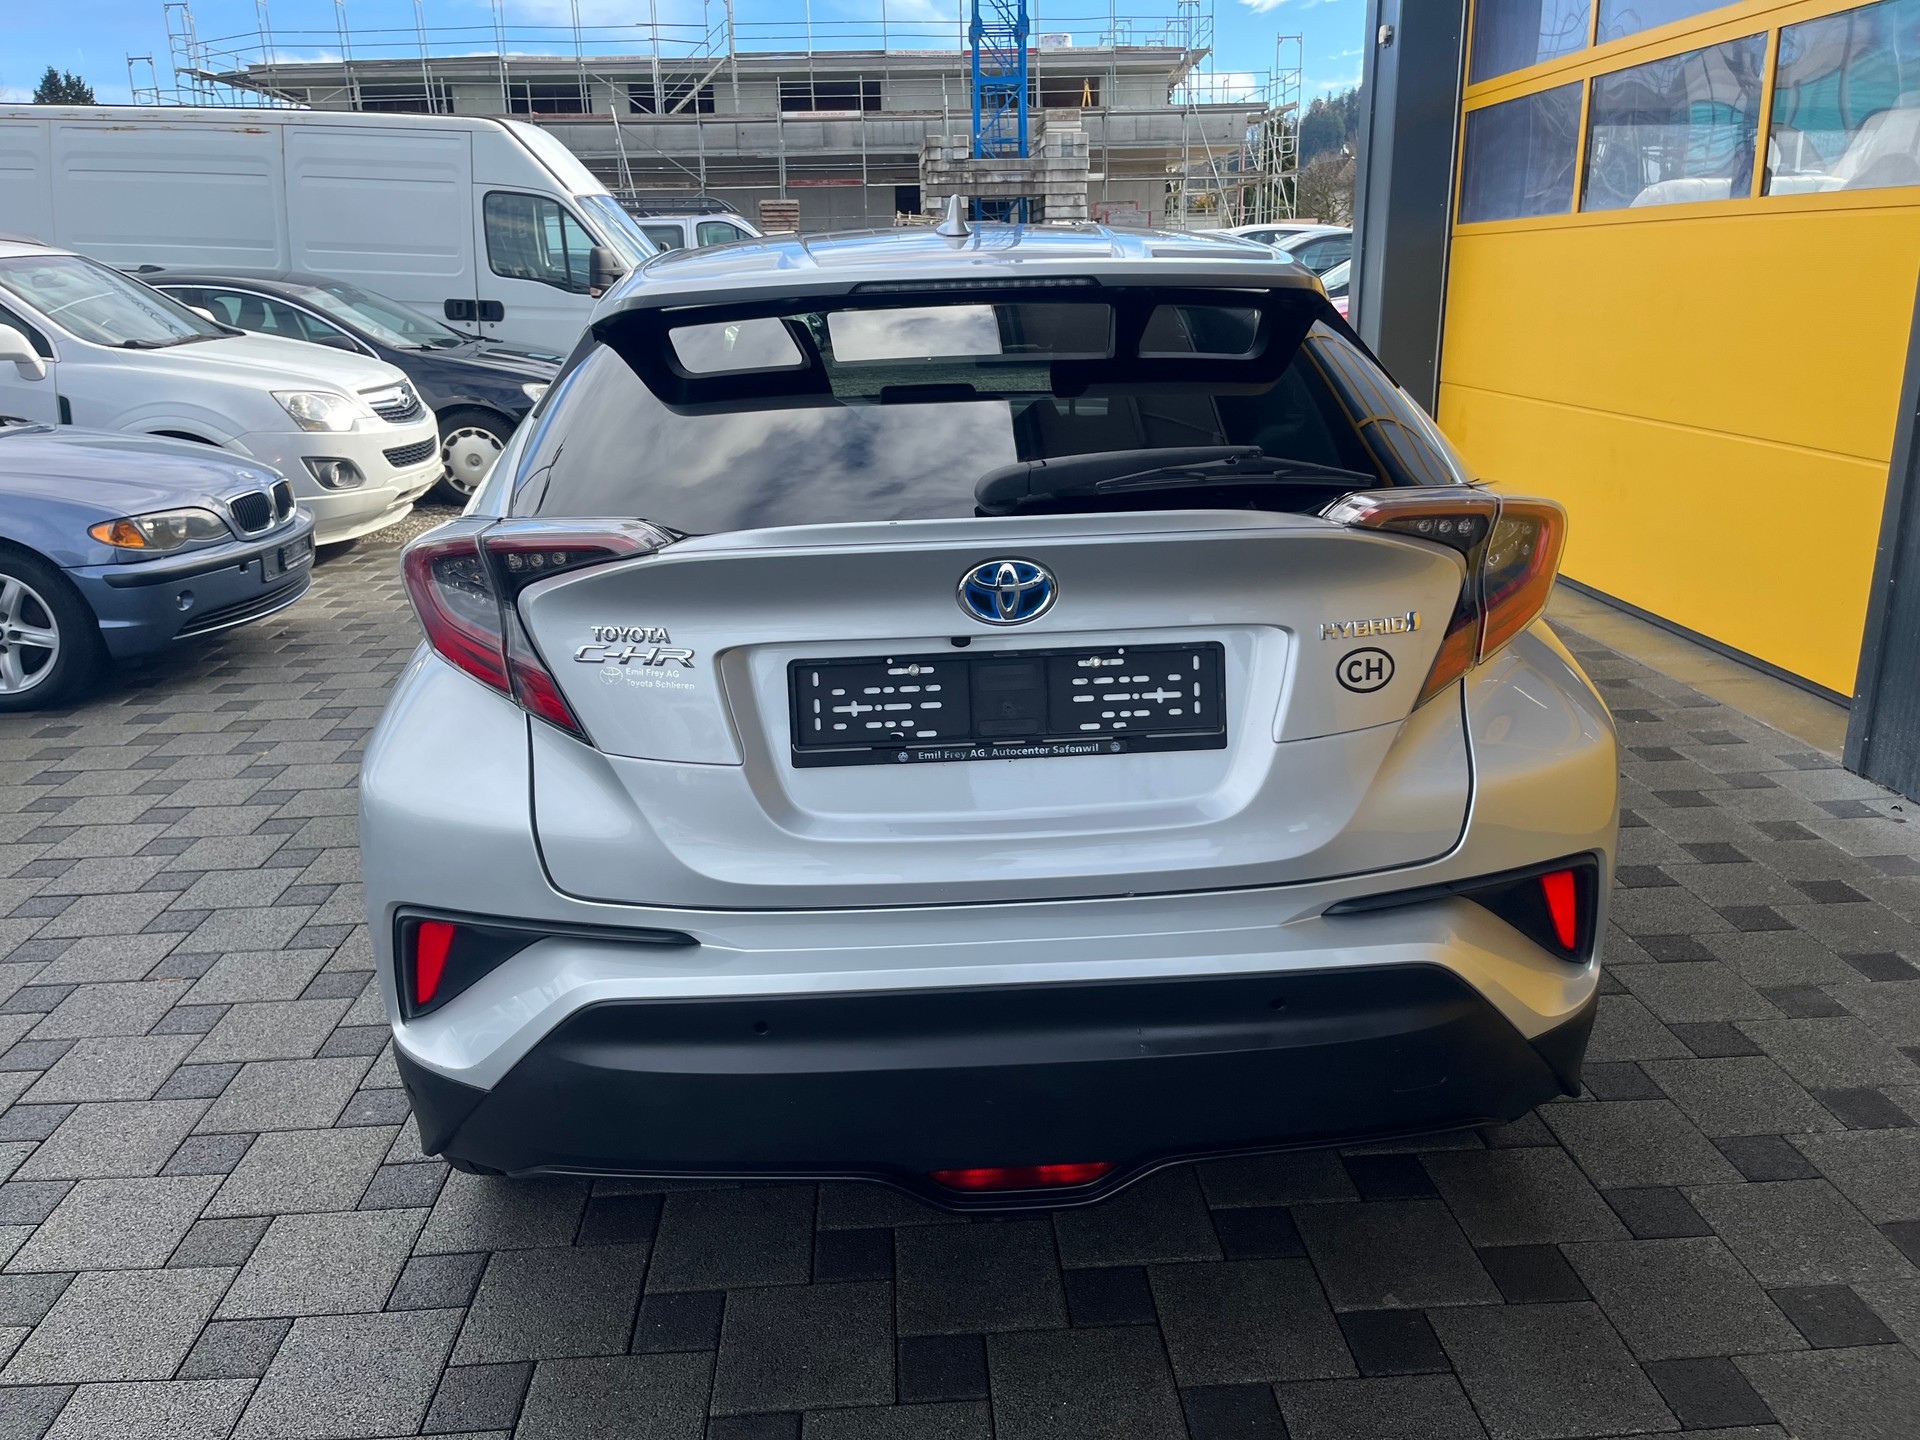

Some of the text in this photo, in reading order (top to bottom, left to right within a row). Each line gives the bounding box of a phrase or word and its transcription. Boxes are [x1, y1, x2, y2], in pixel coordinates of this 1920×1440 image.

[591, 625, 671, 644] TOYOTA
[1319, 616, 1408, 640] HYBRID
[573, 644, 695, 668] C-HR
[625, 667, 680, 679] Emil Frey AG
[1346, 658, 1383, 683] CH
[626, 679, 695, 690] Toyota Schlieren
[918, 751, 941, 760] Emil
[944, 751, 966, 760] Frey
[991, 746, 1050, 757] Autocenter
[1052, 743, 1099, 754] Safenwil
